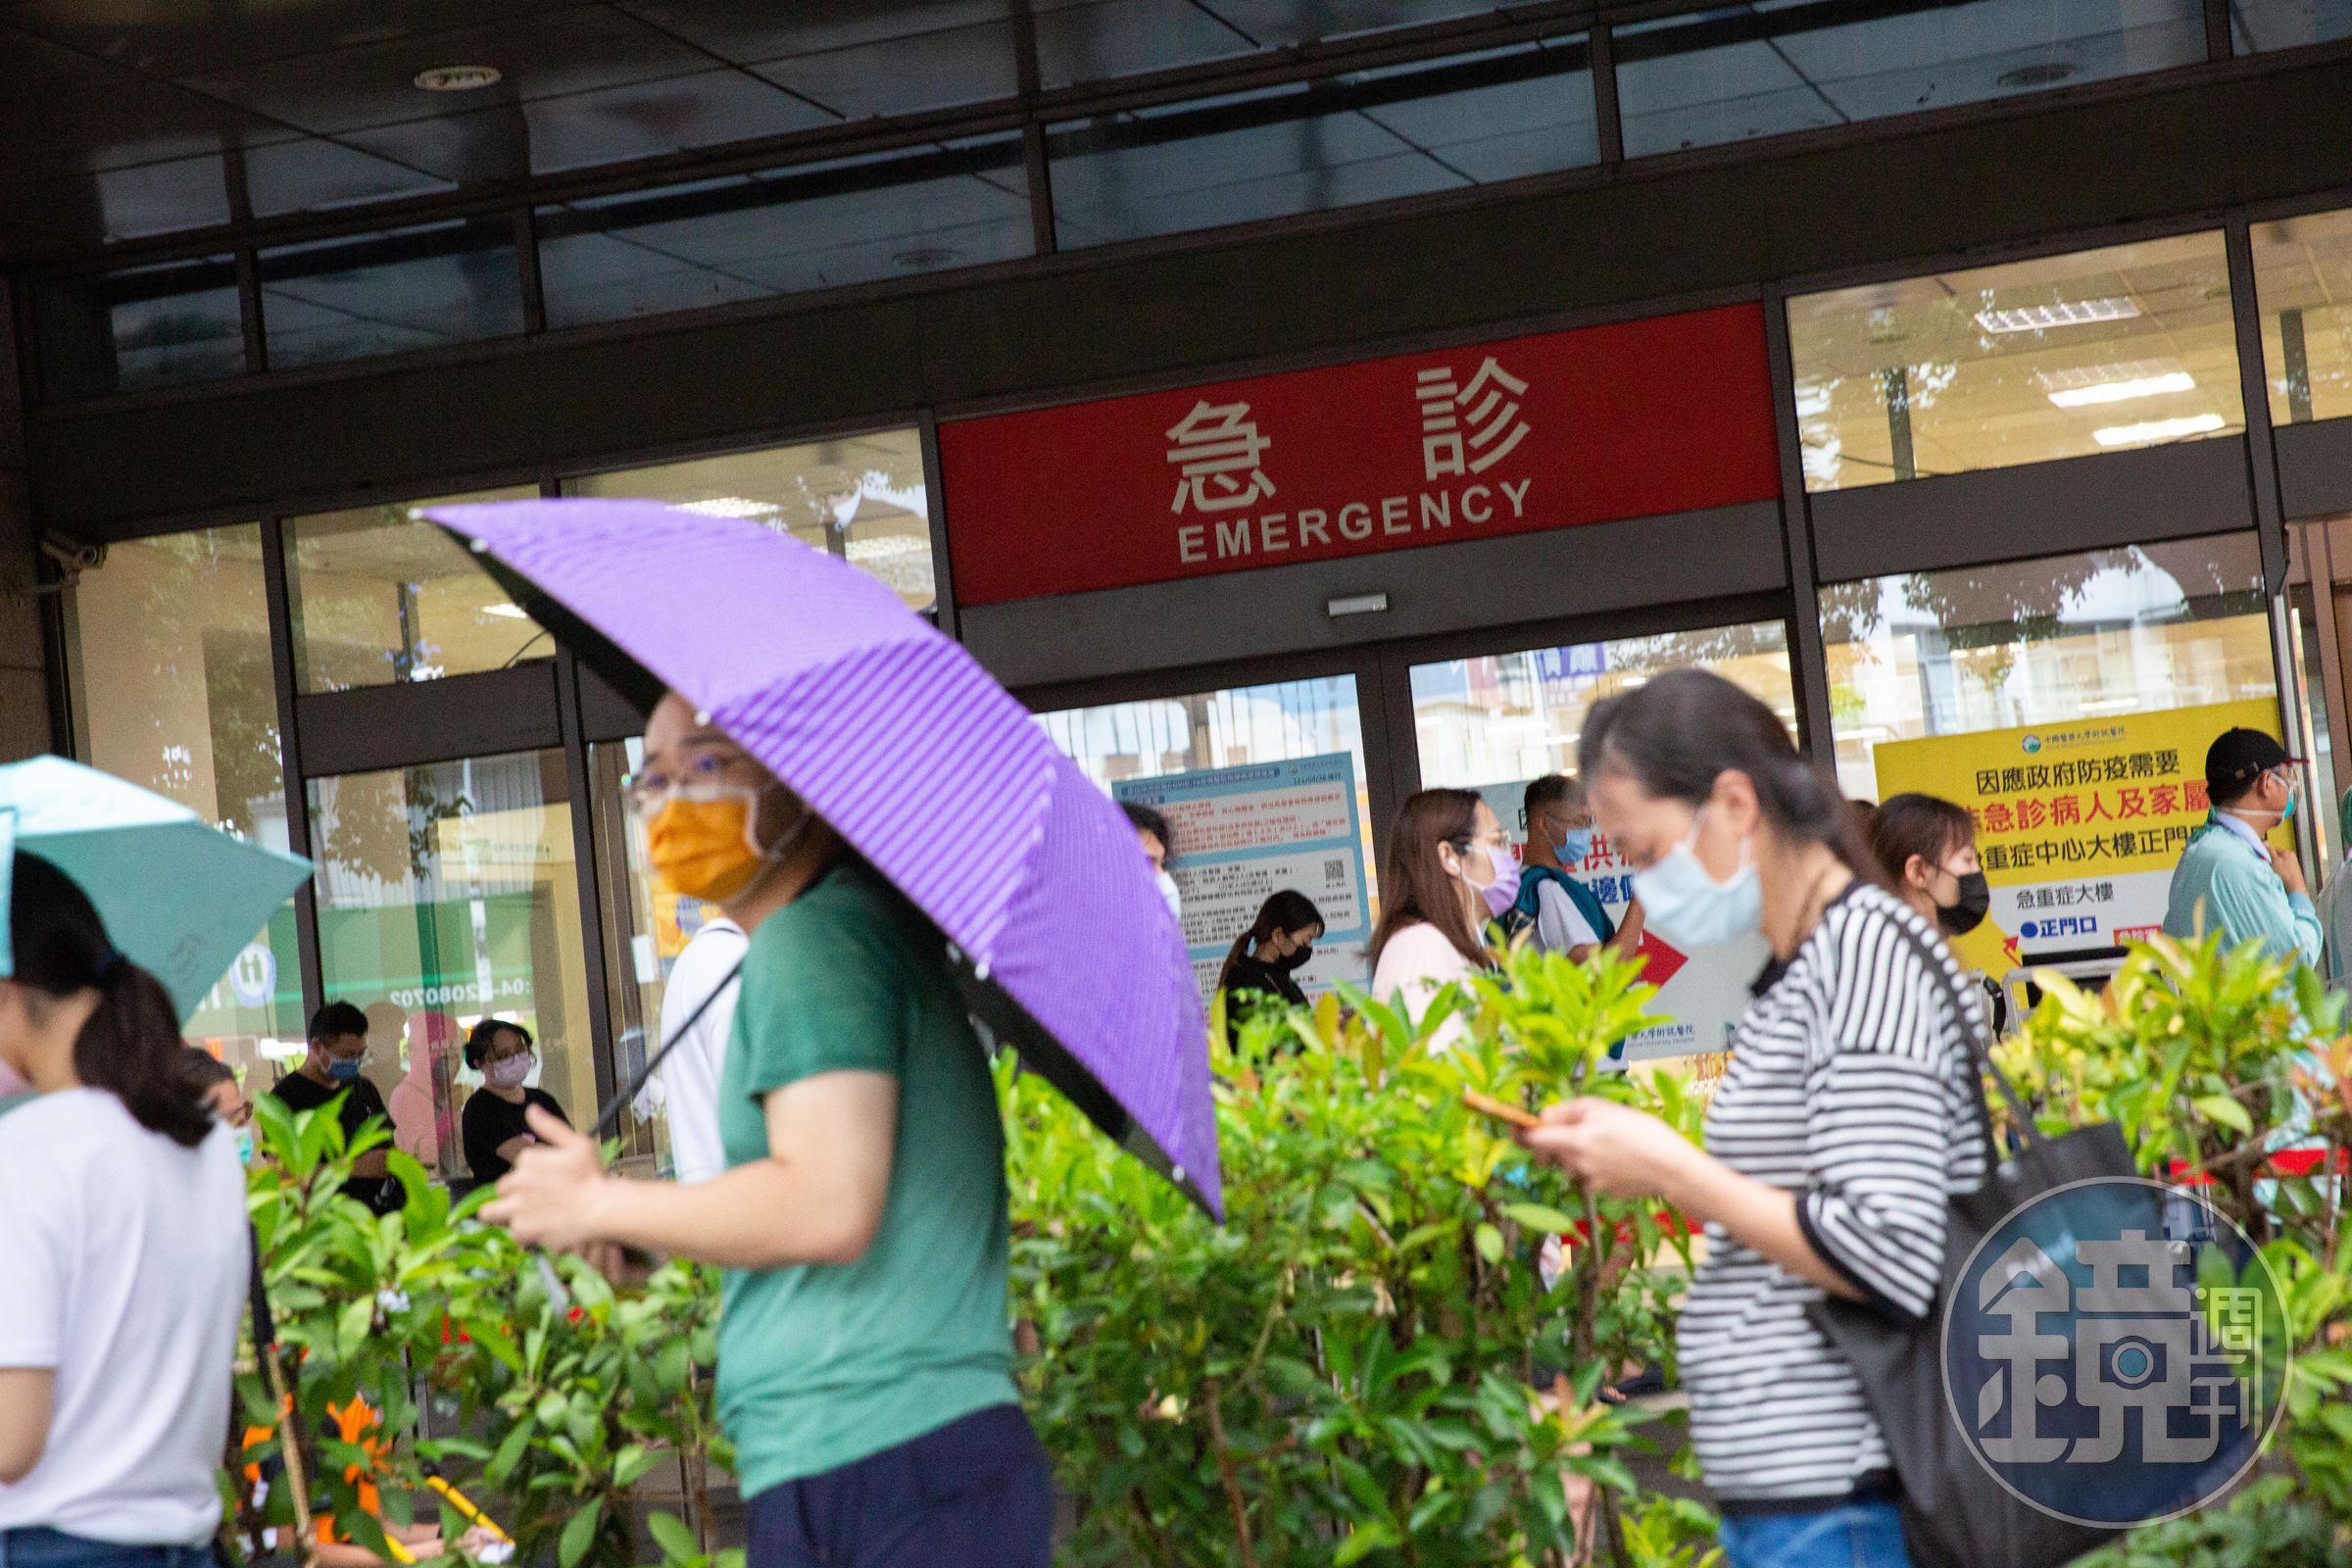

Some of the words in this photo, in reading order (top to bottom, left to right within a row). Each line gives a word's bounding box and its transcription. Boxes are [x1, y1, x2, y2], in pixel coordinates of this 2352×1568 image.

[1178, 478, 1532, 563] EMERGENCY
[1976, 749, 2180, 795] 因應政府防疫需要
[2017, 882, 2114, 909] 急重症大樓
[2039, 915, 2097, 937] 正門口
